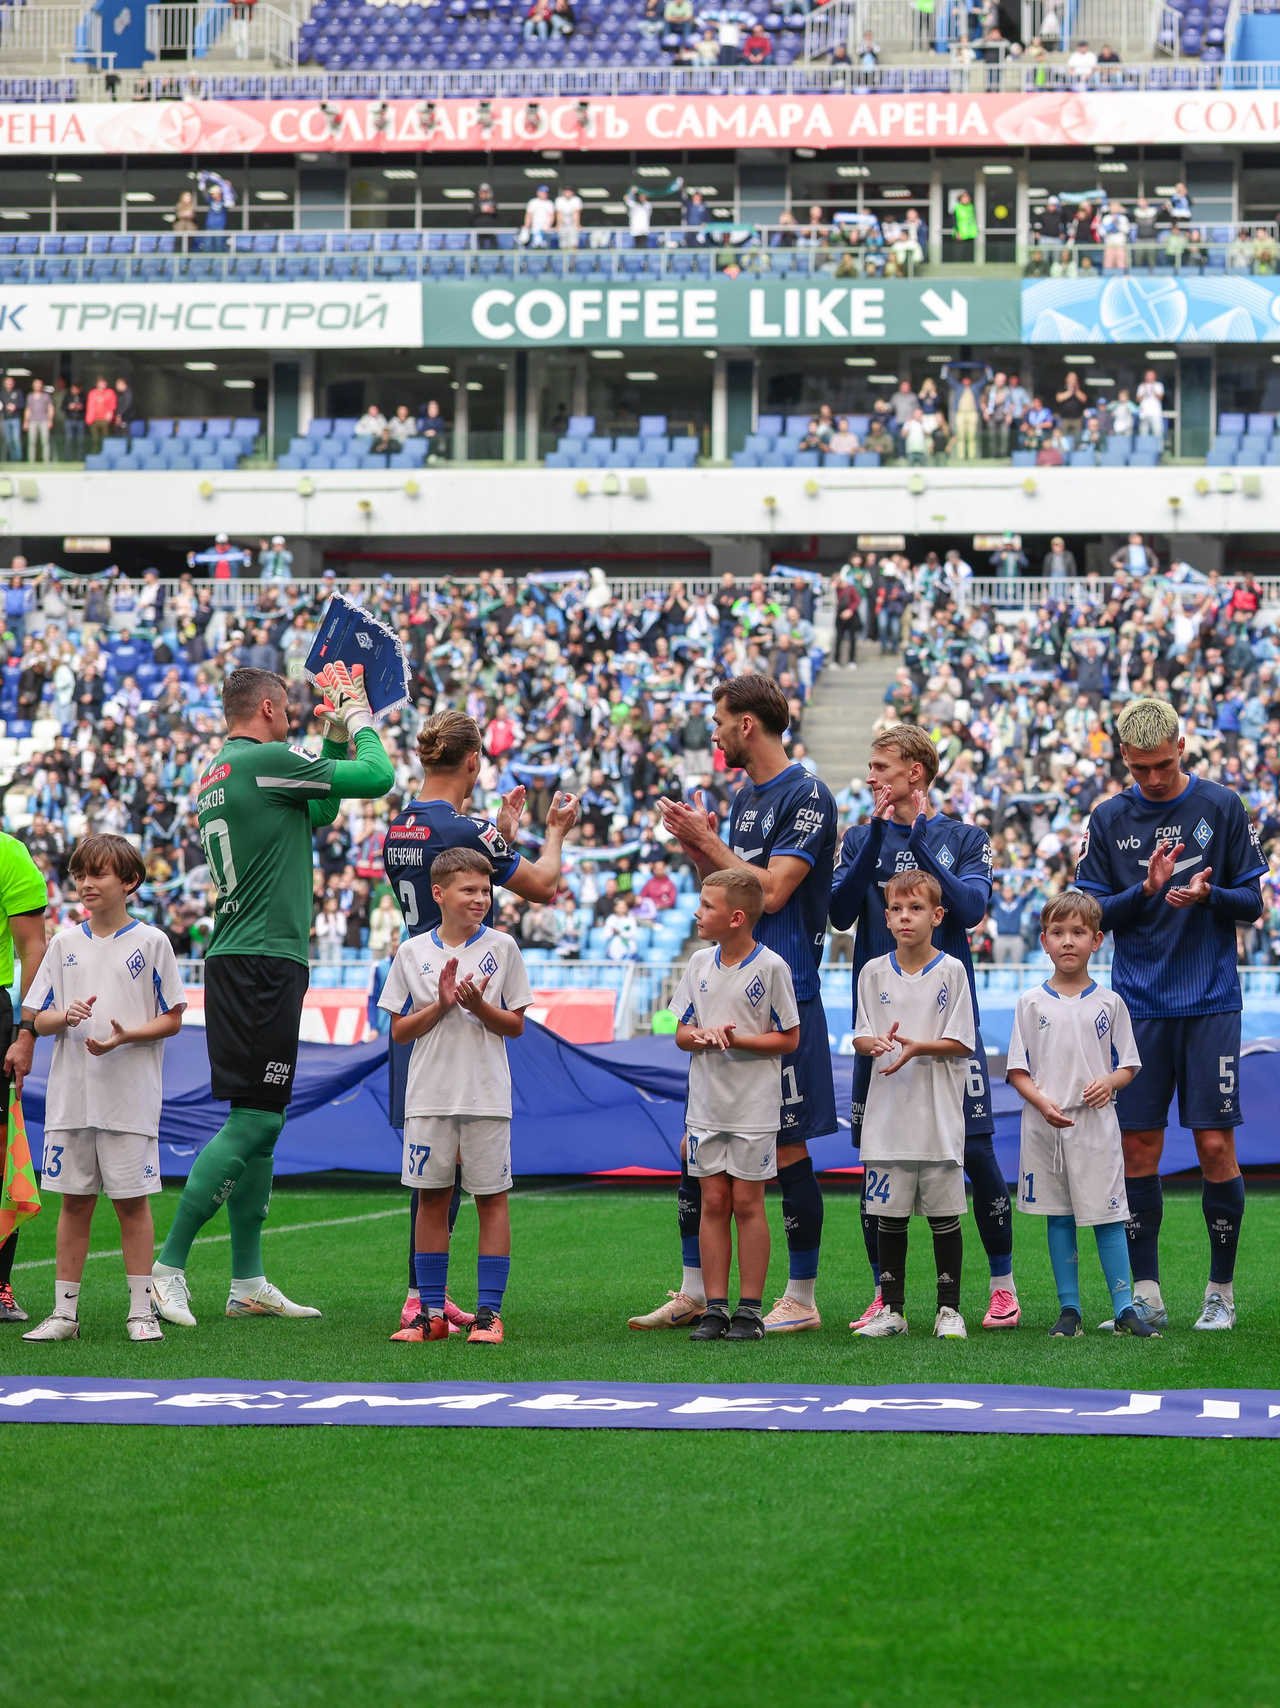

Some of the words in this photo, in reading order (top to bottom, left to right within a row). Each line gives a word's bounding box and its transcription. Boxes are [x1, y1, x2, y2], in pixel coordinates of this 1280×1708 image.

[645, 102, 833, 138] САМАРА
[848, 101, 989, 137] АРЕНА
[50, 294, 389, 331] ТРАНССТРОЙ
[471, 289, 718, 339] COFFEE
[749, 288, 886, 337] LIKE
[742, 810, 758, 821] FON
[796, 808, 825, 823] FON
[740, 821, 755, 832] BET
[793, 819, 822, 834] BET
[1154, 825, 1182, 838] FON
[1116, 835, 1142, 850] wb
[387, 847, 423, 866] ПЕЧЕНИН
[895, 851, 915, 862] FO
[265, 1061, 291, 1074] FON
[1219, 1055, 1235, 1094] 5
[263, 1072, 289, 1085] BET
[782, 1066, 804, 1105] 1
[966, 1059, 985, 1097] 6
[783, 1121, 799, 1129] KELME
[42, 1144, 65, 1178] 13
[408, 1143, 431, 1176] 37
[865, 1169, 890, 1204] 24
[1023, 1171, 1036, 1203] 1
[1123, 1221, 1141, 1229] ELME
